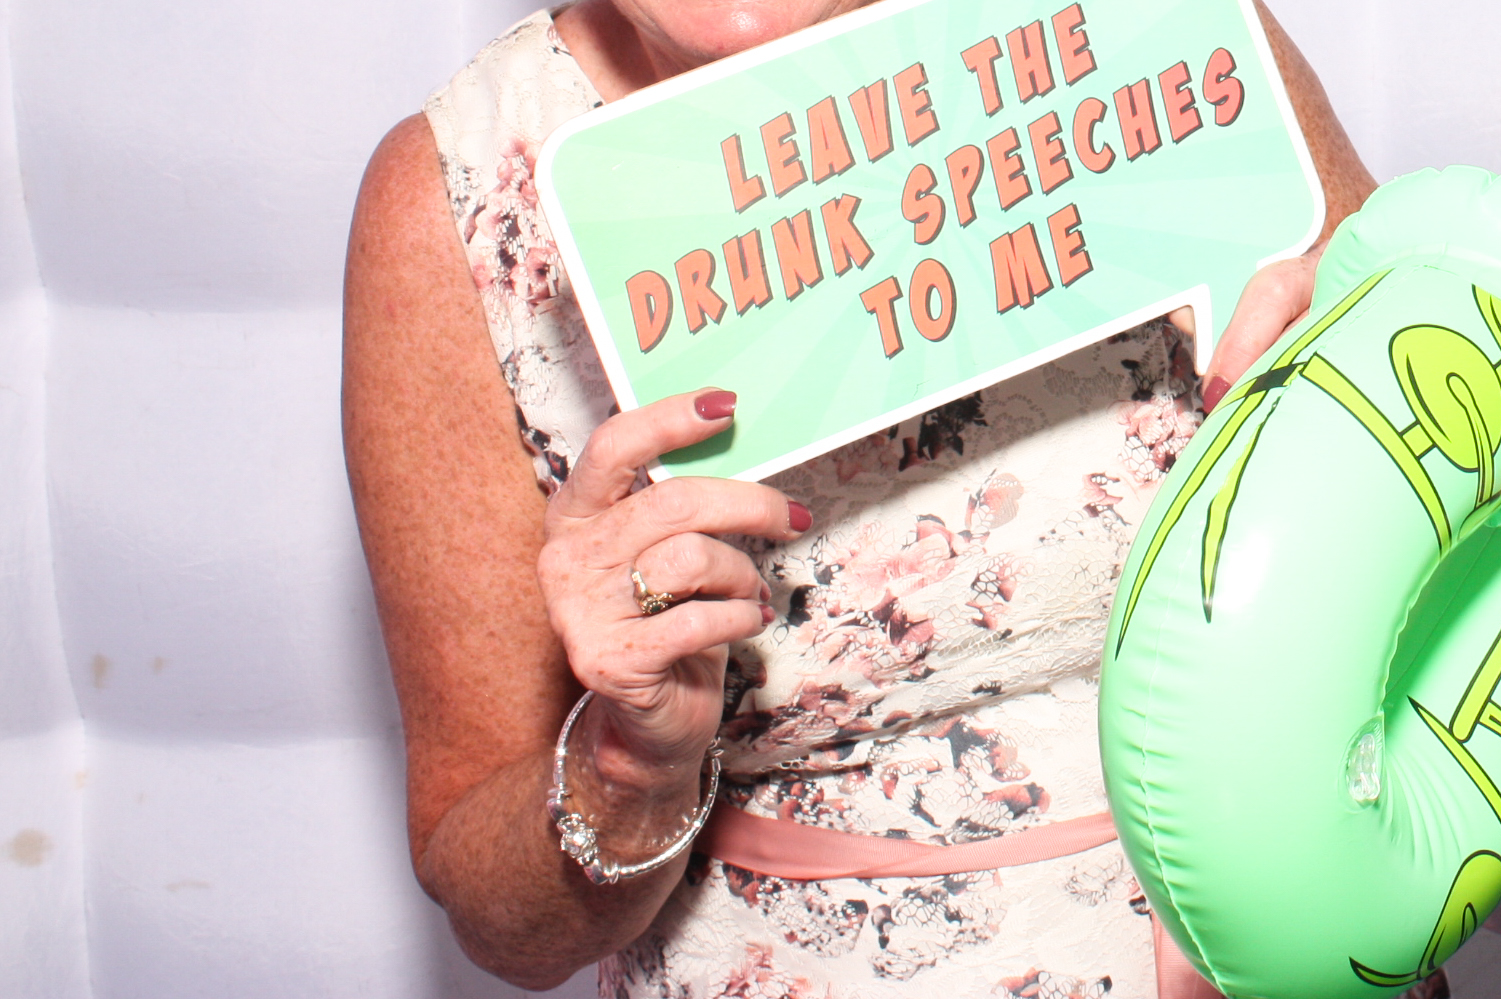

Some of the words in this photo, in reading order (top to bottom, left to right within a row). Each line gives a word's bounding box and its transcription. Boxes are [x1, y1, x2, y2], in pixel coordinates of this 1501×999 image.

[626, 193, 874, 354] DRUNK
[901, 47, 1245, 246] SPEECHES
[720, 61, 940, 213] LEAVE
[961, 1, 1098, 117] THE
[860, 258, 957, 359] TO
[988, 203, 1093, 315] ME
